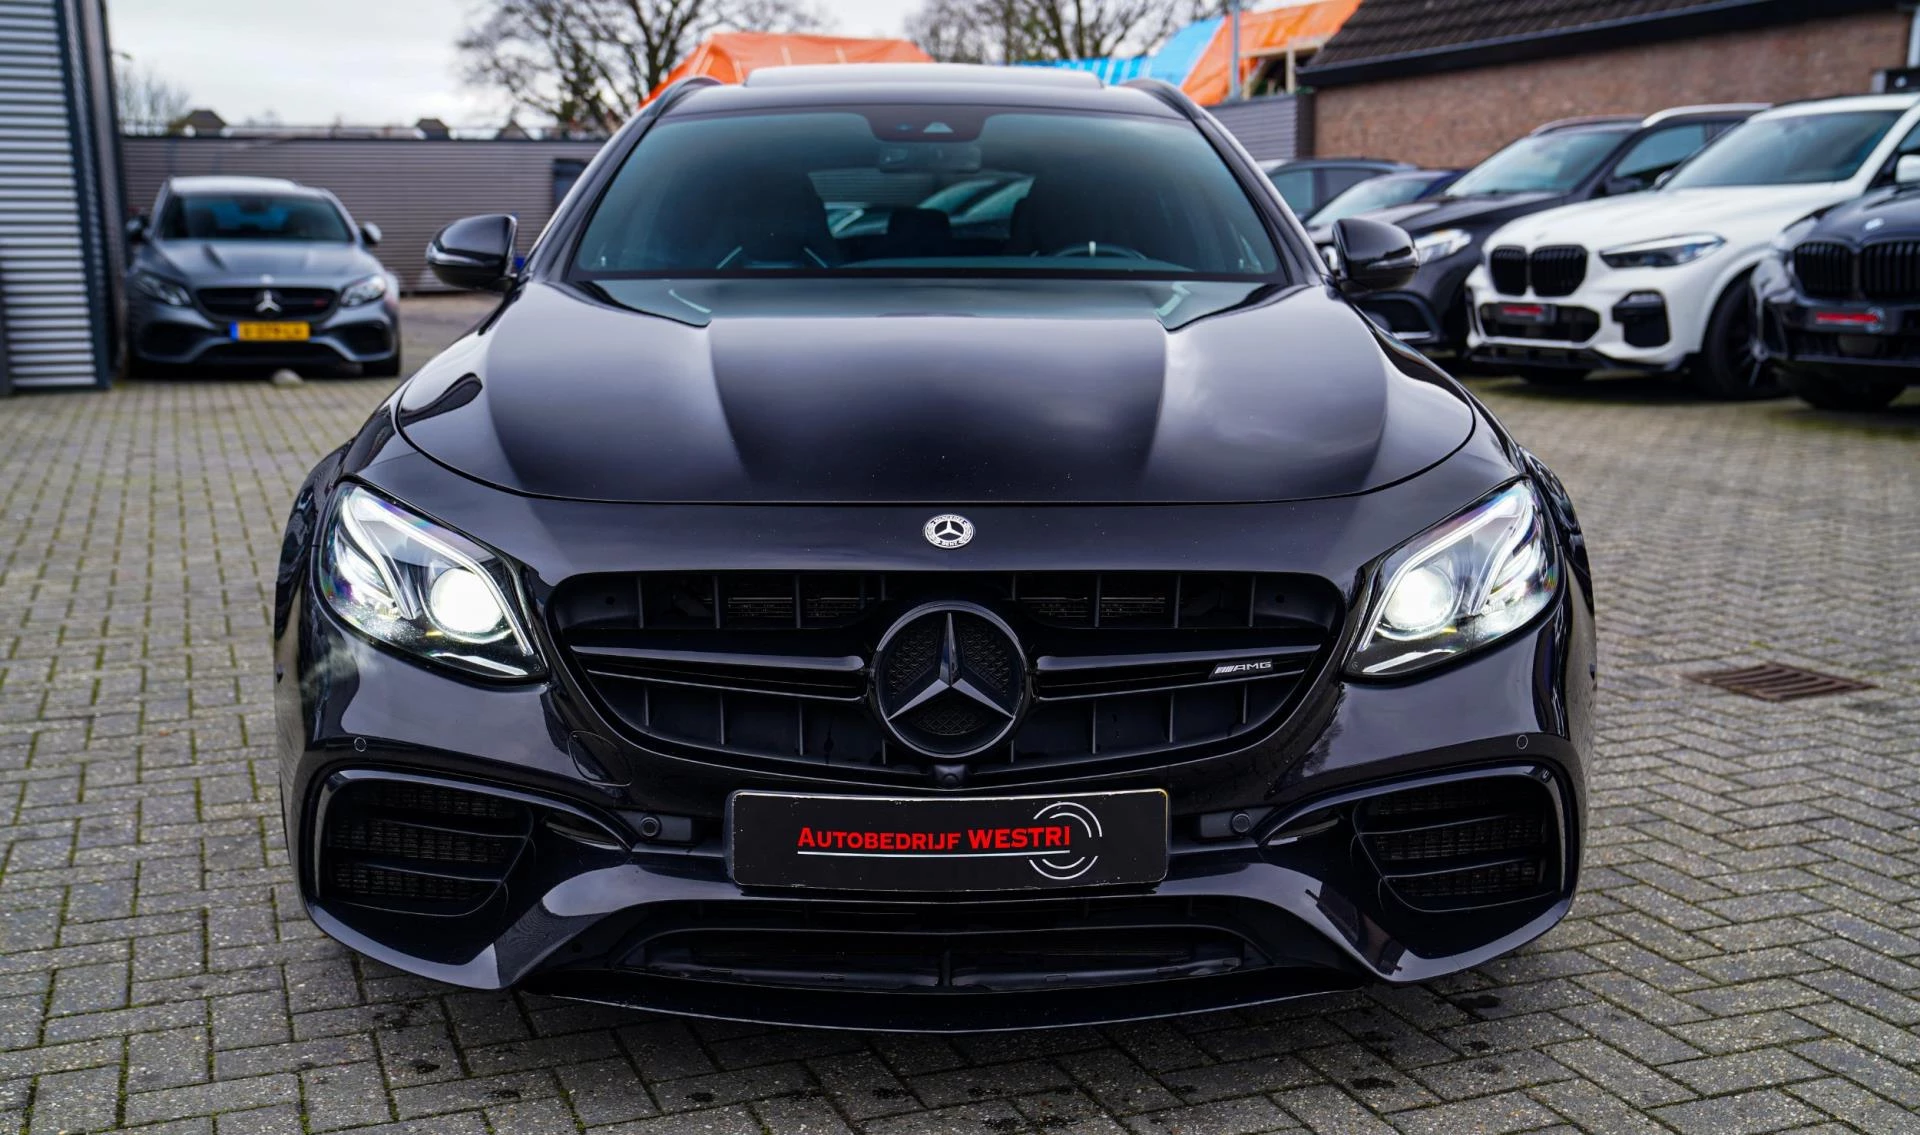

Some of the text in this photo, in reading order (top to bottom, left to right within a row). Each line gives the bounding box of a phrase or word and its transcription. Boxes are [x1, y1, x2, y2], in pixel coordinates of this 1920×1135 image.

[1232, 661, 1272, 672] AMG
[797, 825, 1070, 850] AUTOBEDRIJF WESTRI
